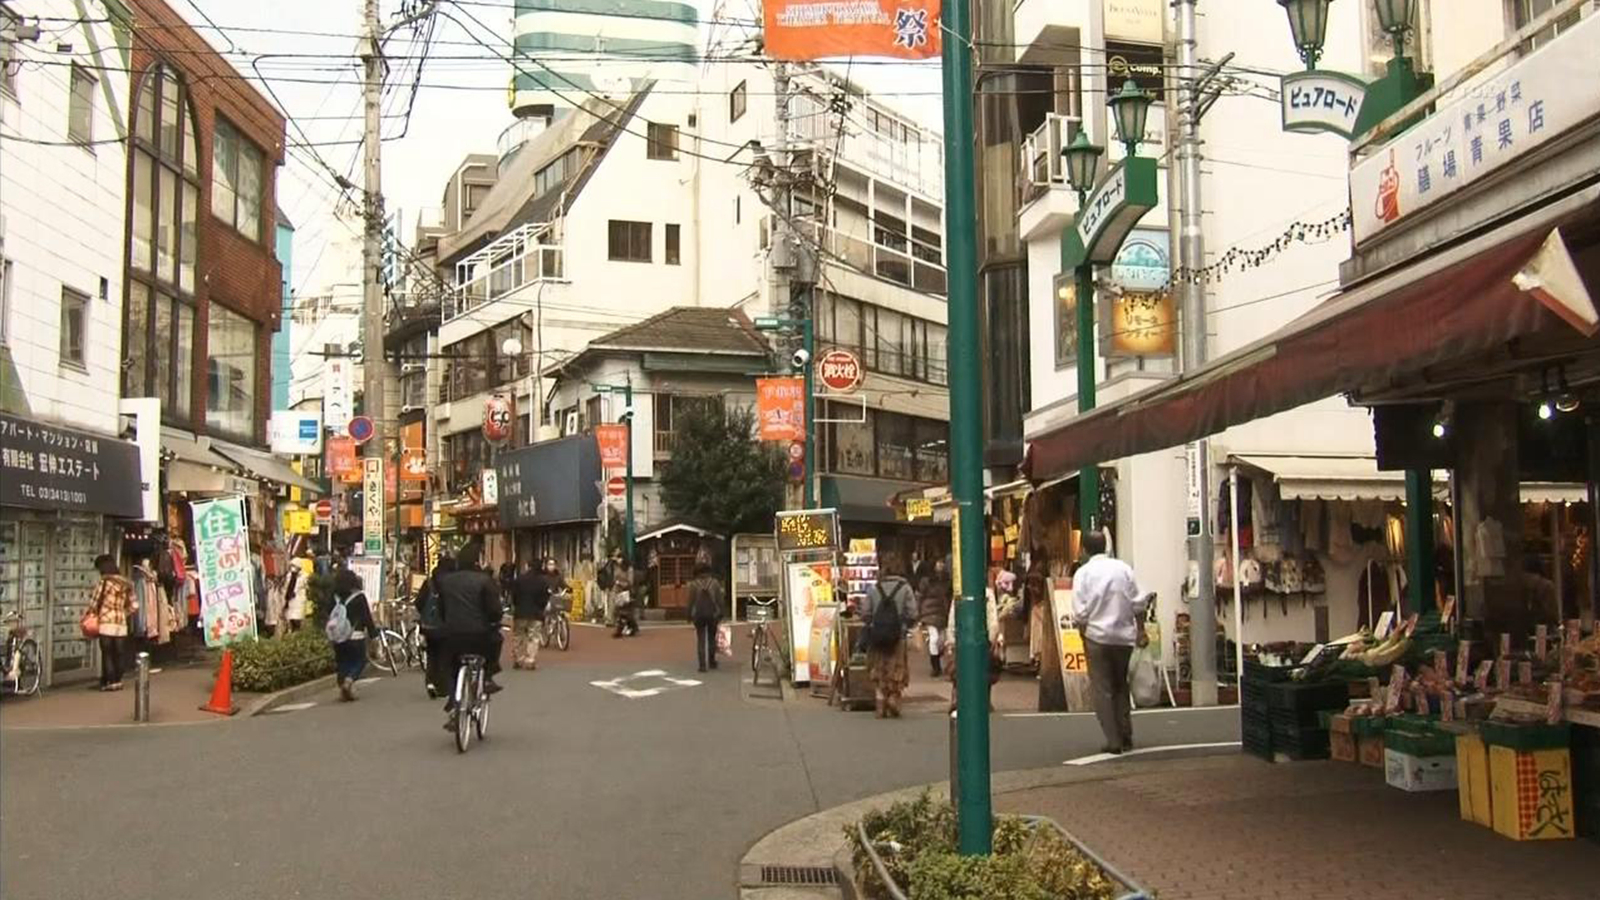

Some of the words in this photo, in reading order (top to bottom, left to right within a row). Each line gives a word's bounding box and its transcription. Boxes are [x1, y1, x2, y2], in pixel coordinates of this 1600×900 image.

[894, 8, 927, 48] 祭
[1291, 86, 1357, 117] ピュアロード
[1415, 125, 1451, 161] フルーツ
[1083, 177, 1122, 235] ピュアロード
[823, 363, 856, 380] 消火栓
[20, 483, 36, 498] TEL
